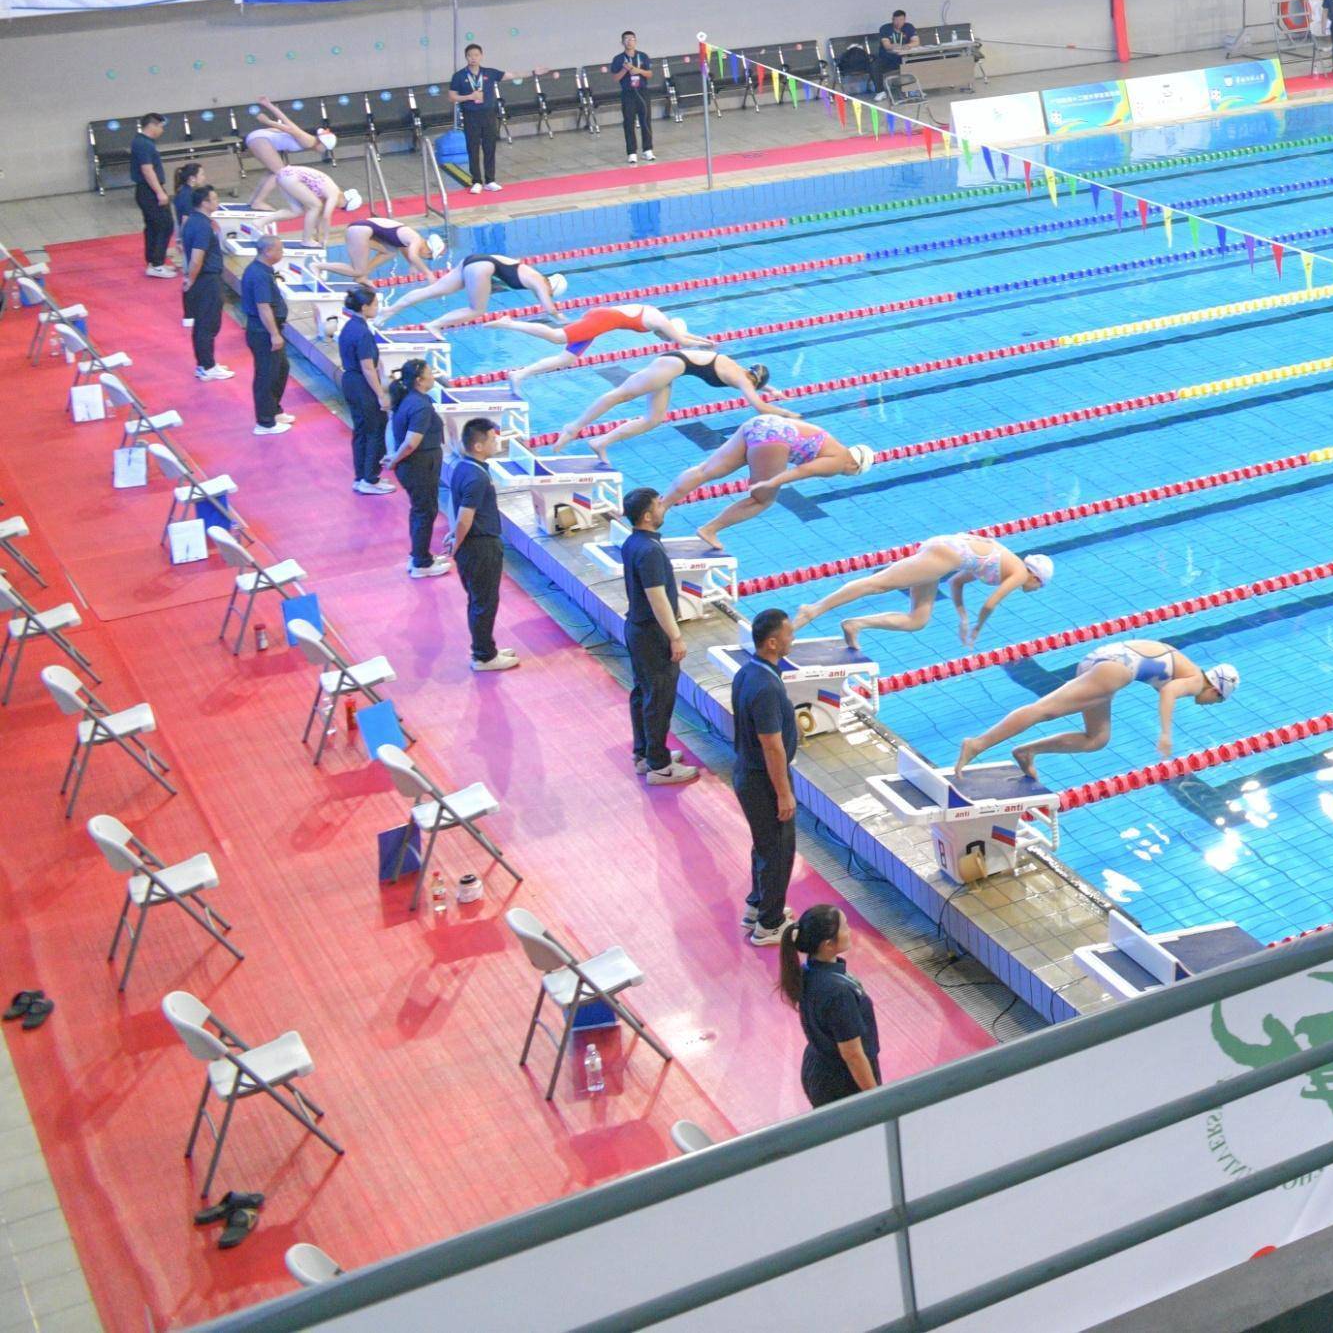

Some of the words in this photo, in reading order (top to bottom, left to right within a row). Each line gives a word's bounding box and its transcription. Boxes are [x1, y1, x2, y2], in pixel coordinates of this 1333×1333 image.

[828, 670, 846, 678] anti
[954, 810, 970, 819] anti
[1004, 804, 1023, 813] anti
